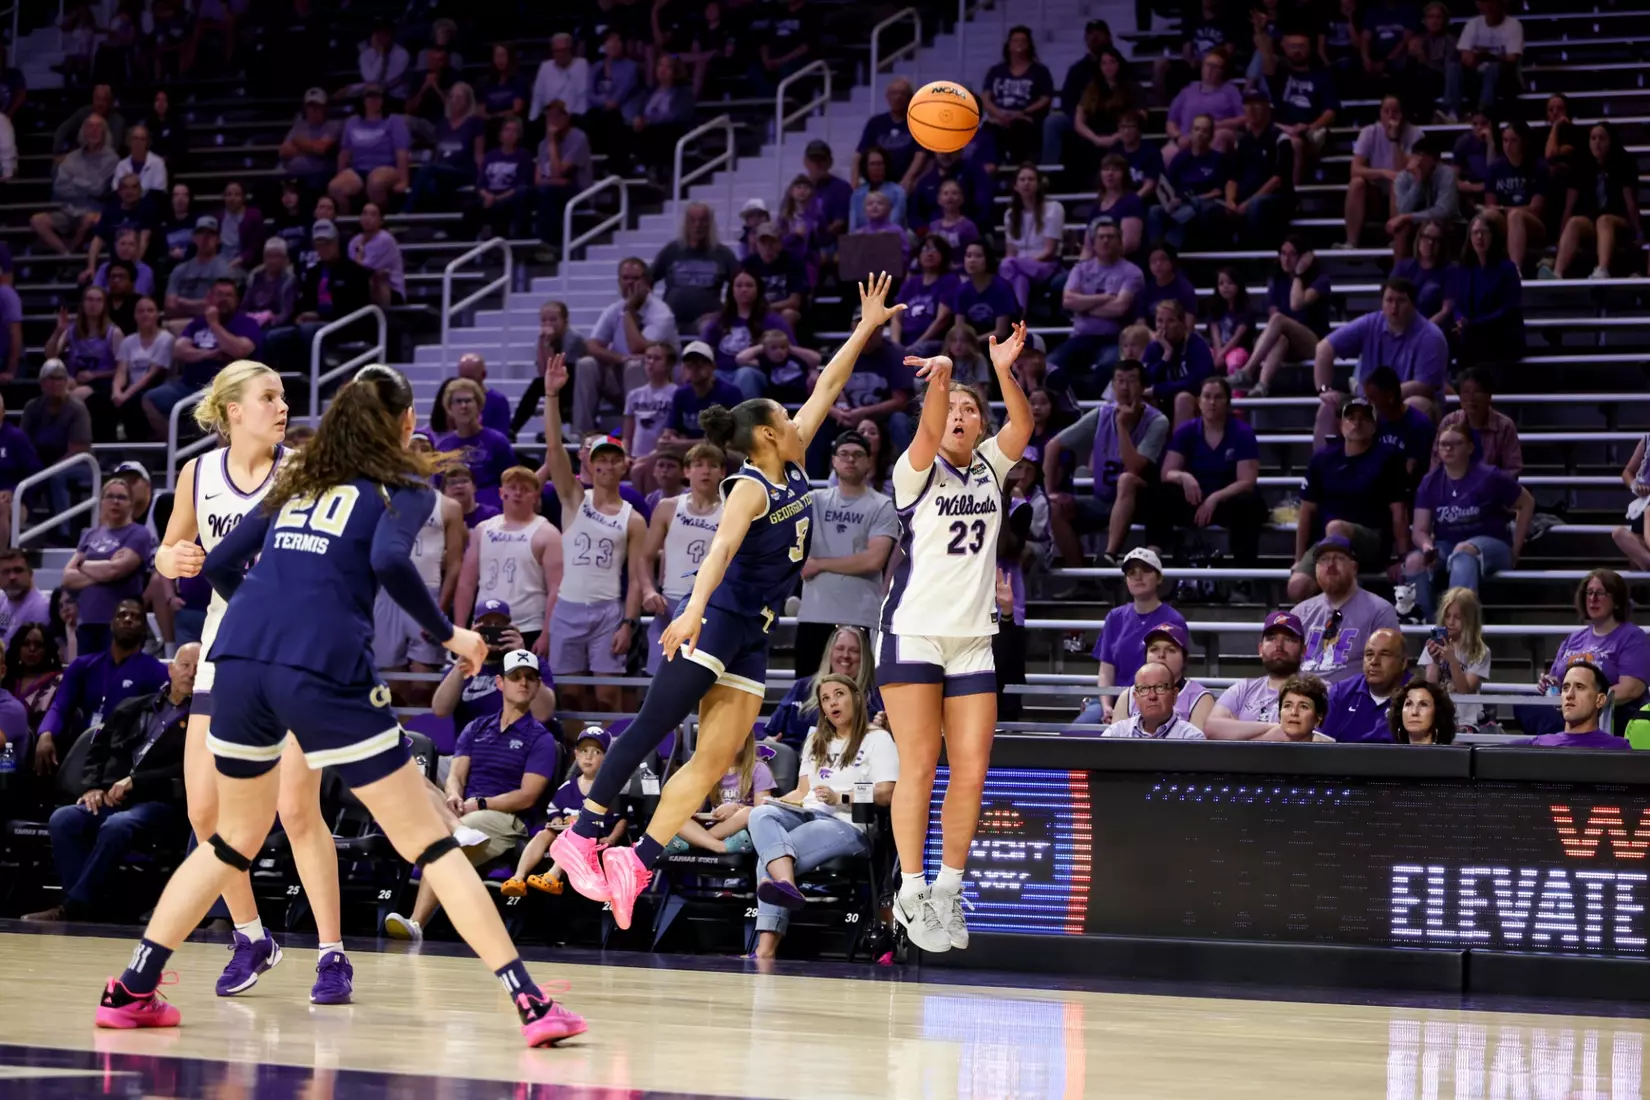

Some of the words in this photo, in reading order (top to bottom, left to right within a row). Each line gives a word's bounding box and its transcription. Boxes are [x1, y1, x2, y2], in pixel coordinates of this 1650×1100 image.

[931, 86, 966, 100] NCAA
[274, 485, 360, 537] 20
[769, 499, 804, 525] GEORGIA
[935, 493, 997, 516] Wildcats
[824, 509, 864, 524] EMAW
[274, 532, 330, 555] TERMIS
[788, 516, 809, 563] 3
[946, 519, 986, 556] 23
[572, 532, 614, 570] 23
[687, 539, 706, 564] 4
[485, 557, 517, 591] 34
[286, 885, 300, 895] 25
[378, 889, 392, 900] 26
[506, 896, 520, 906] 27
[744, 907, 758, 918] 29
[1391, 865, 1648, 946] ELEVATE
[844, 912, 859, 923] 30
